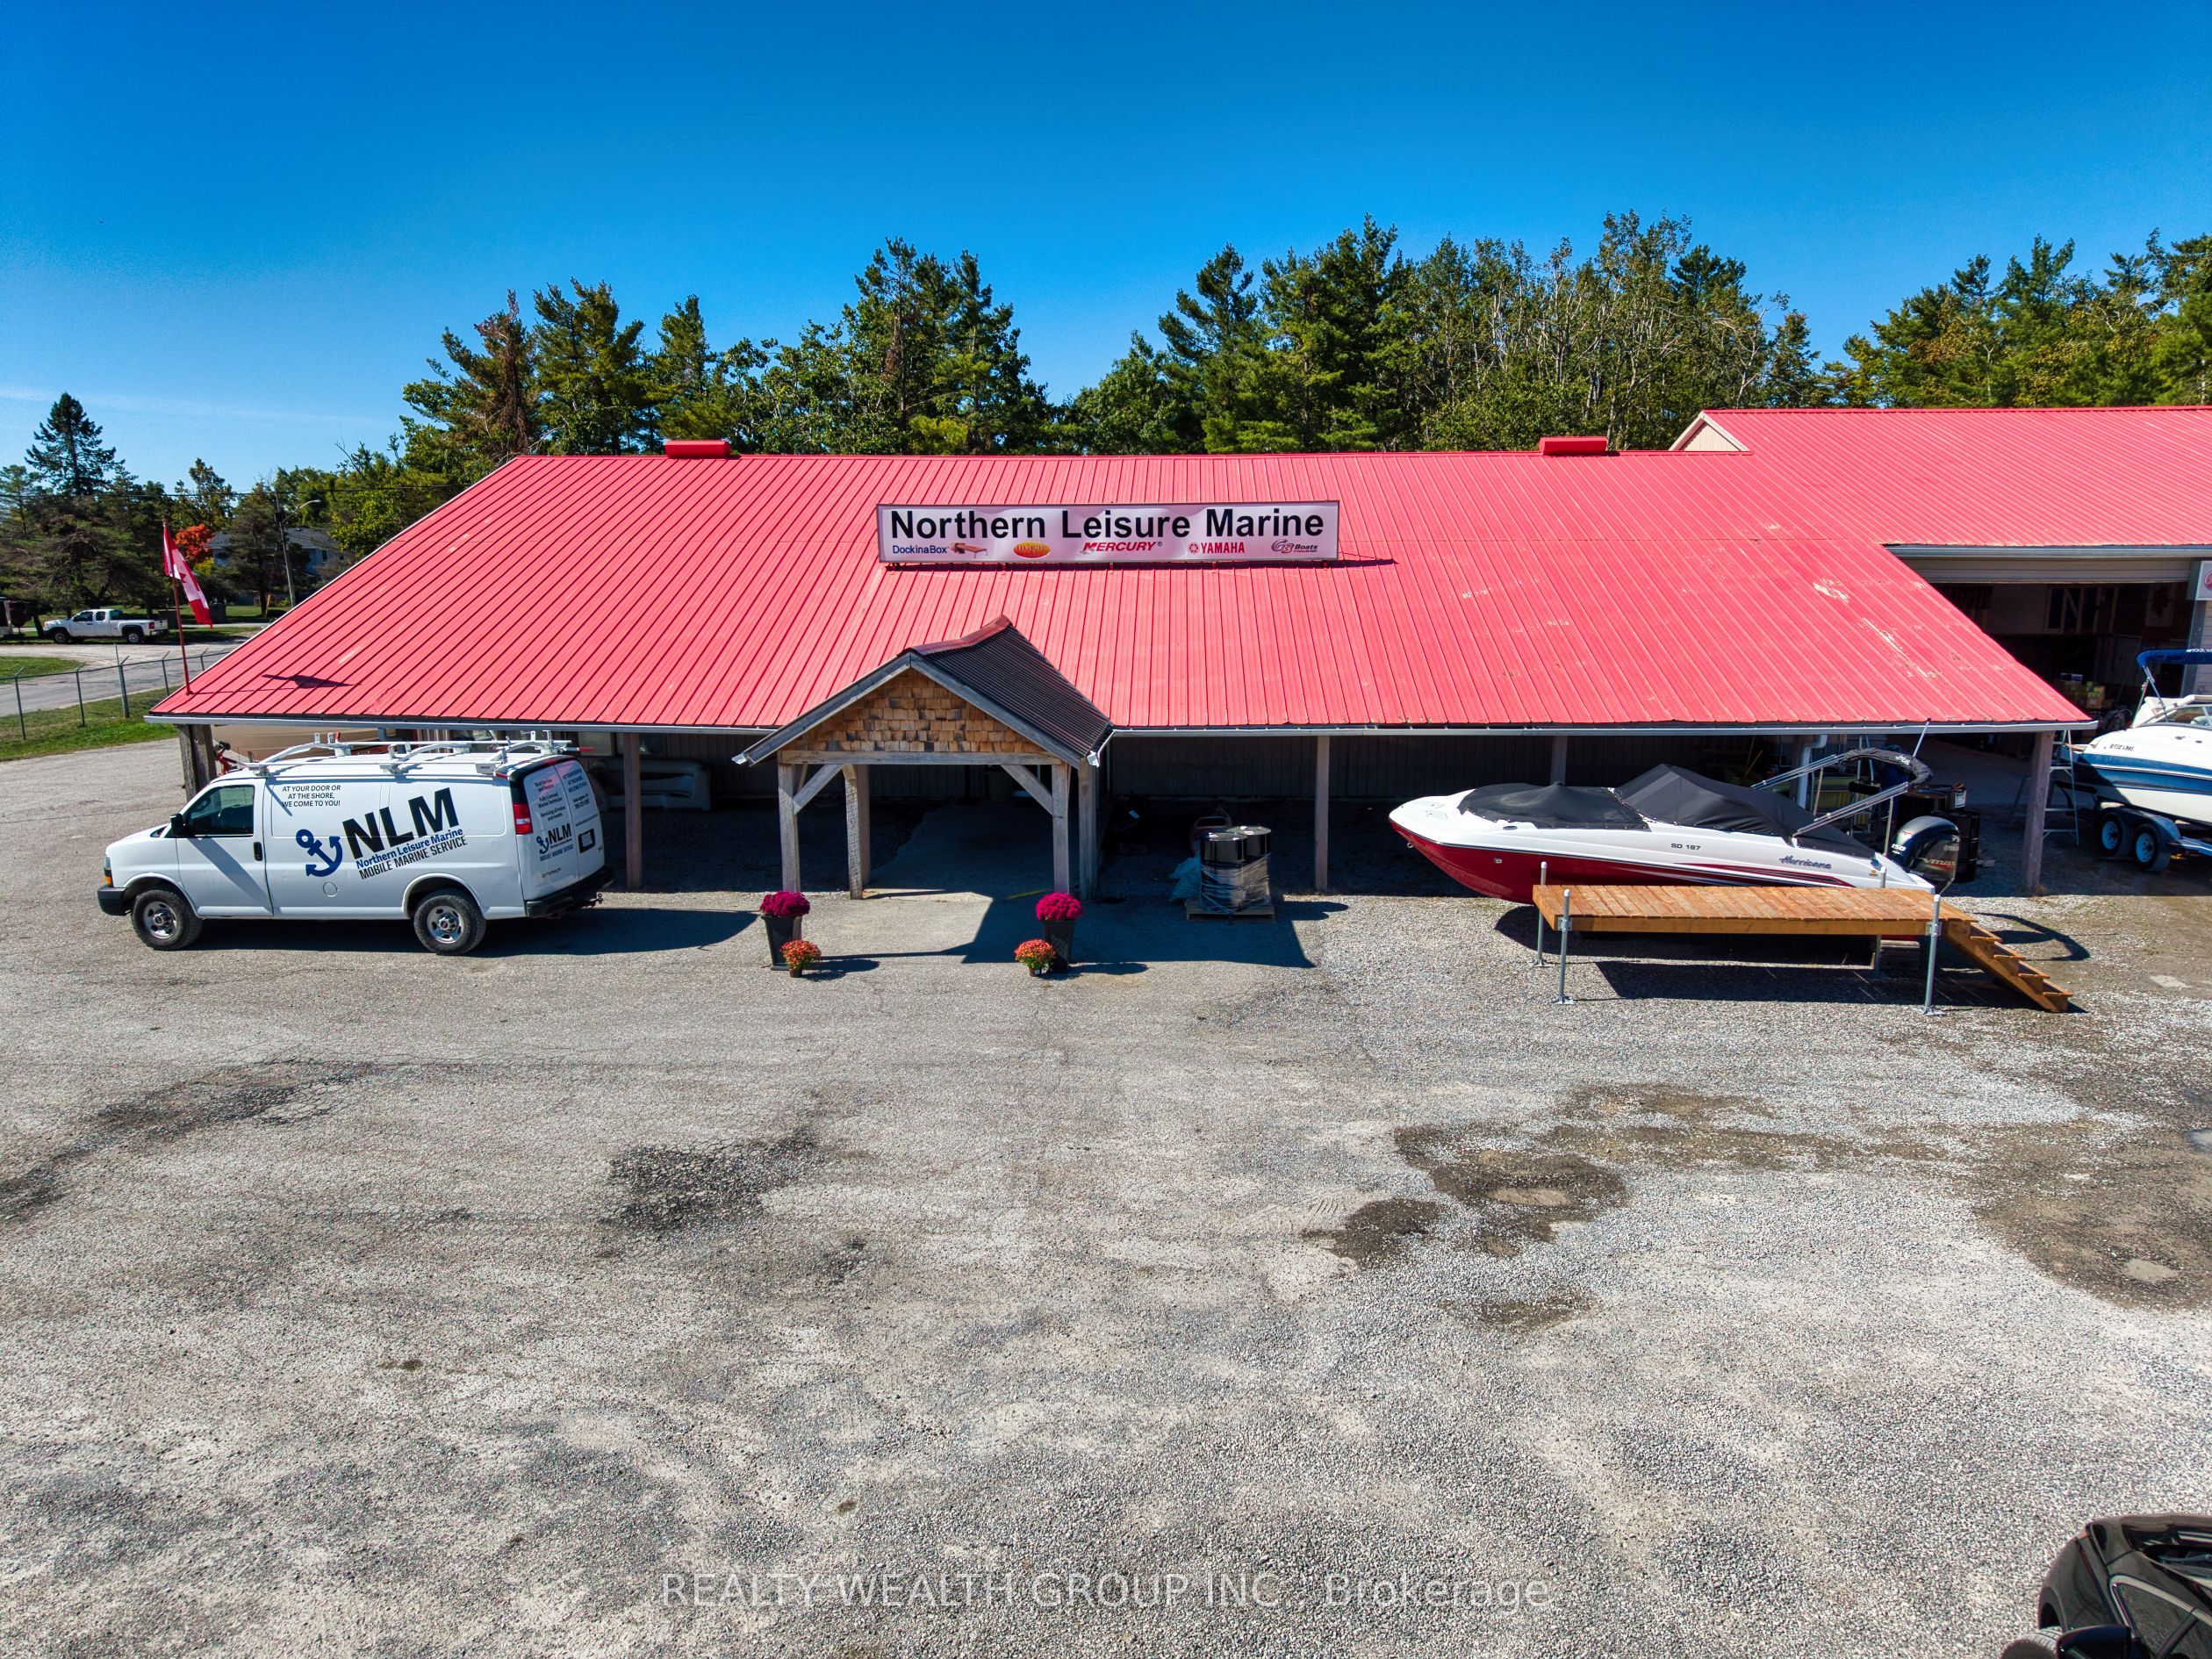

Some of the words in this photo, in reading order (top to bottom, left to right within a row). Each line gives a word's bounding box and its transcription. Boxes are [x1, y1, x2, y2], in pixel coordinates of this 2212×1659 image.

[891, 510, 1045, 539] Northern
[1062, 509, 1190, 538] Leisure
[1206, 508, 1324, 537] Marine
[892, 545, 947, 554] DockinaBox
[1082, 542, 1157, 552] MERCURY
[1201, 542, 1245, 554] YAMAHA
[1271, 539, 1295, 554] G3
[342, 786, 459, 859] NLM
[548, 823, 571, 844] NLM
[356, 851, 397, 869] Northern
[396, 839, 430, 857] Leisure
[430, 829, 463, 844] Marine
[359, 860, 393, 880] MOBILE
[394, 847, 430, 868] MARINE
[431, 836, 468, 856] SERVICE
[1778, 855, 1832, 869] Hurricane
